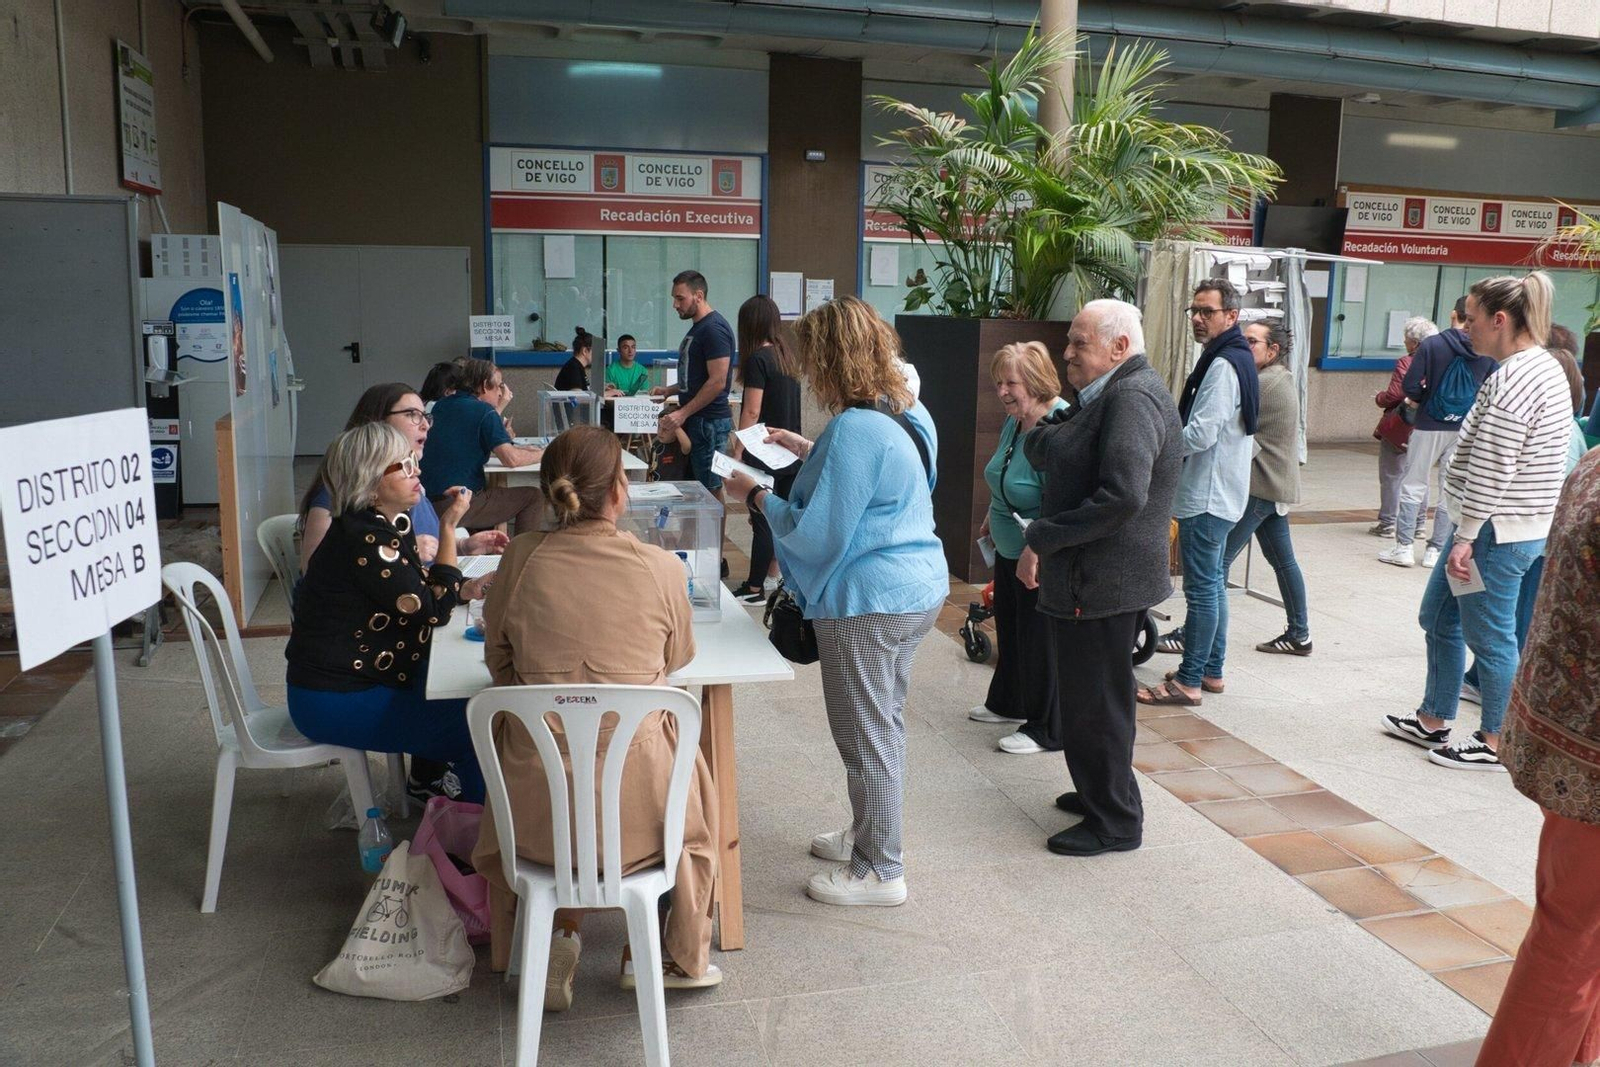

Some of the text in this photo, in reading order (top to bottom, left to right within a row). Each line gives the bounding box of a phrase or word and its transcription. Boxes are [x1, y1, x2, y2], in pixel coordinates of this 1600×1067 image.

[516, 159, 585, 172] CONCELLO
[638, 163, 703, 176] CONCELLO
[525, 172, 577, 184] DE VIGO
[646, 176, 695, 188] DE VIGO
[1353, 201, 1399, 211] CONCELLO
[1433, 205, 1477, 216] CONCELLO
[600, 208, 754, 225] Recadación Executiva
[1358, 212, 1392, 221] DE VIGO
[1437, 215, 1471, 226] DE VIGO
[1511, 209, 1553, 220] CONCELLO
[1515, 219, 1547, 229] DE VIGO
[1344, 241, 1449, 255] Recadación Voluntaria
[618, 412, 650, 420] SECCION
[17, 453, 141, 514] DISTRITO 02
[26, 497, 145, 565] SECCION 04
[70, 543, 146, 600] MESA B
[350, 926, 418, 945] FIELDING
